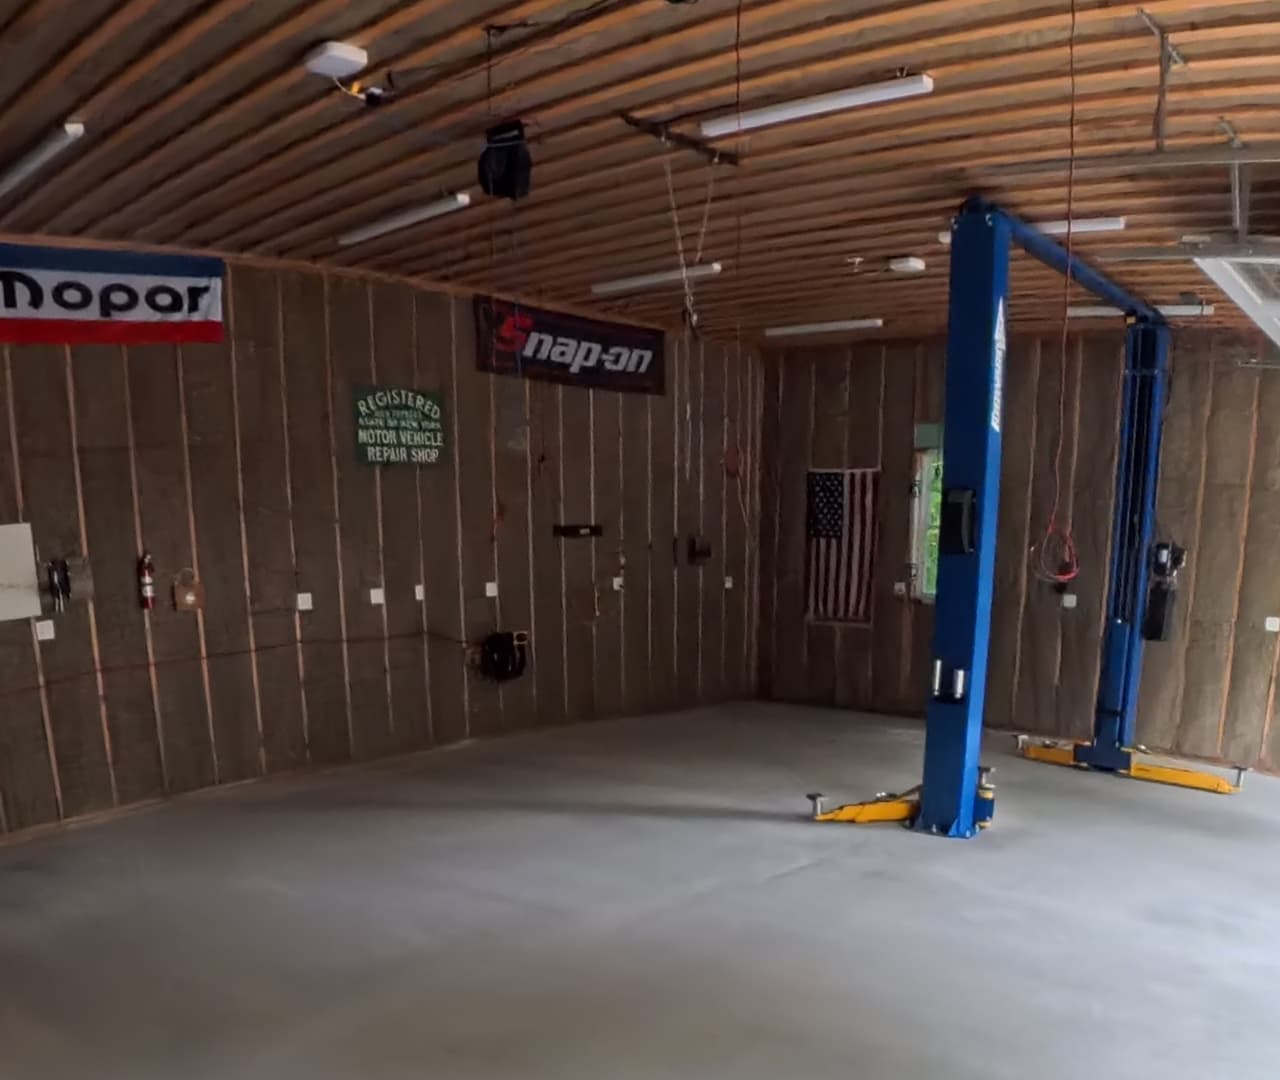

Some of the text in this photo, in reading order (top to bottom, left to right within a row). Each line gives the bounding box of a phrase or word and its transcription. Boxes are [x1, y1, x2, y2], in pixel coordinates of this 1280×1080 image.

[495, 314, 653, 373] Snap-on
[358, 390, 440, 419] REGISTERED
[358, 429, 444, 446] MOTOR VEHICLE
[368, 446, 439, 463] REPAIR SHOP
